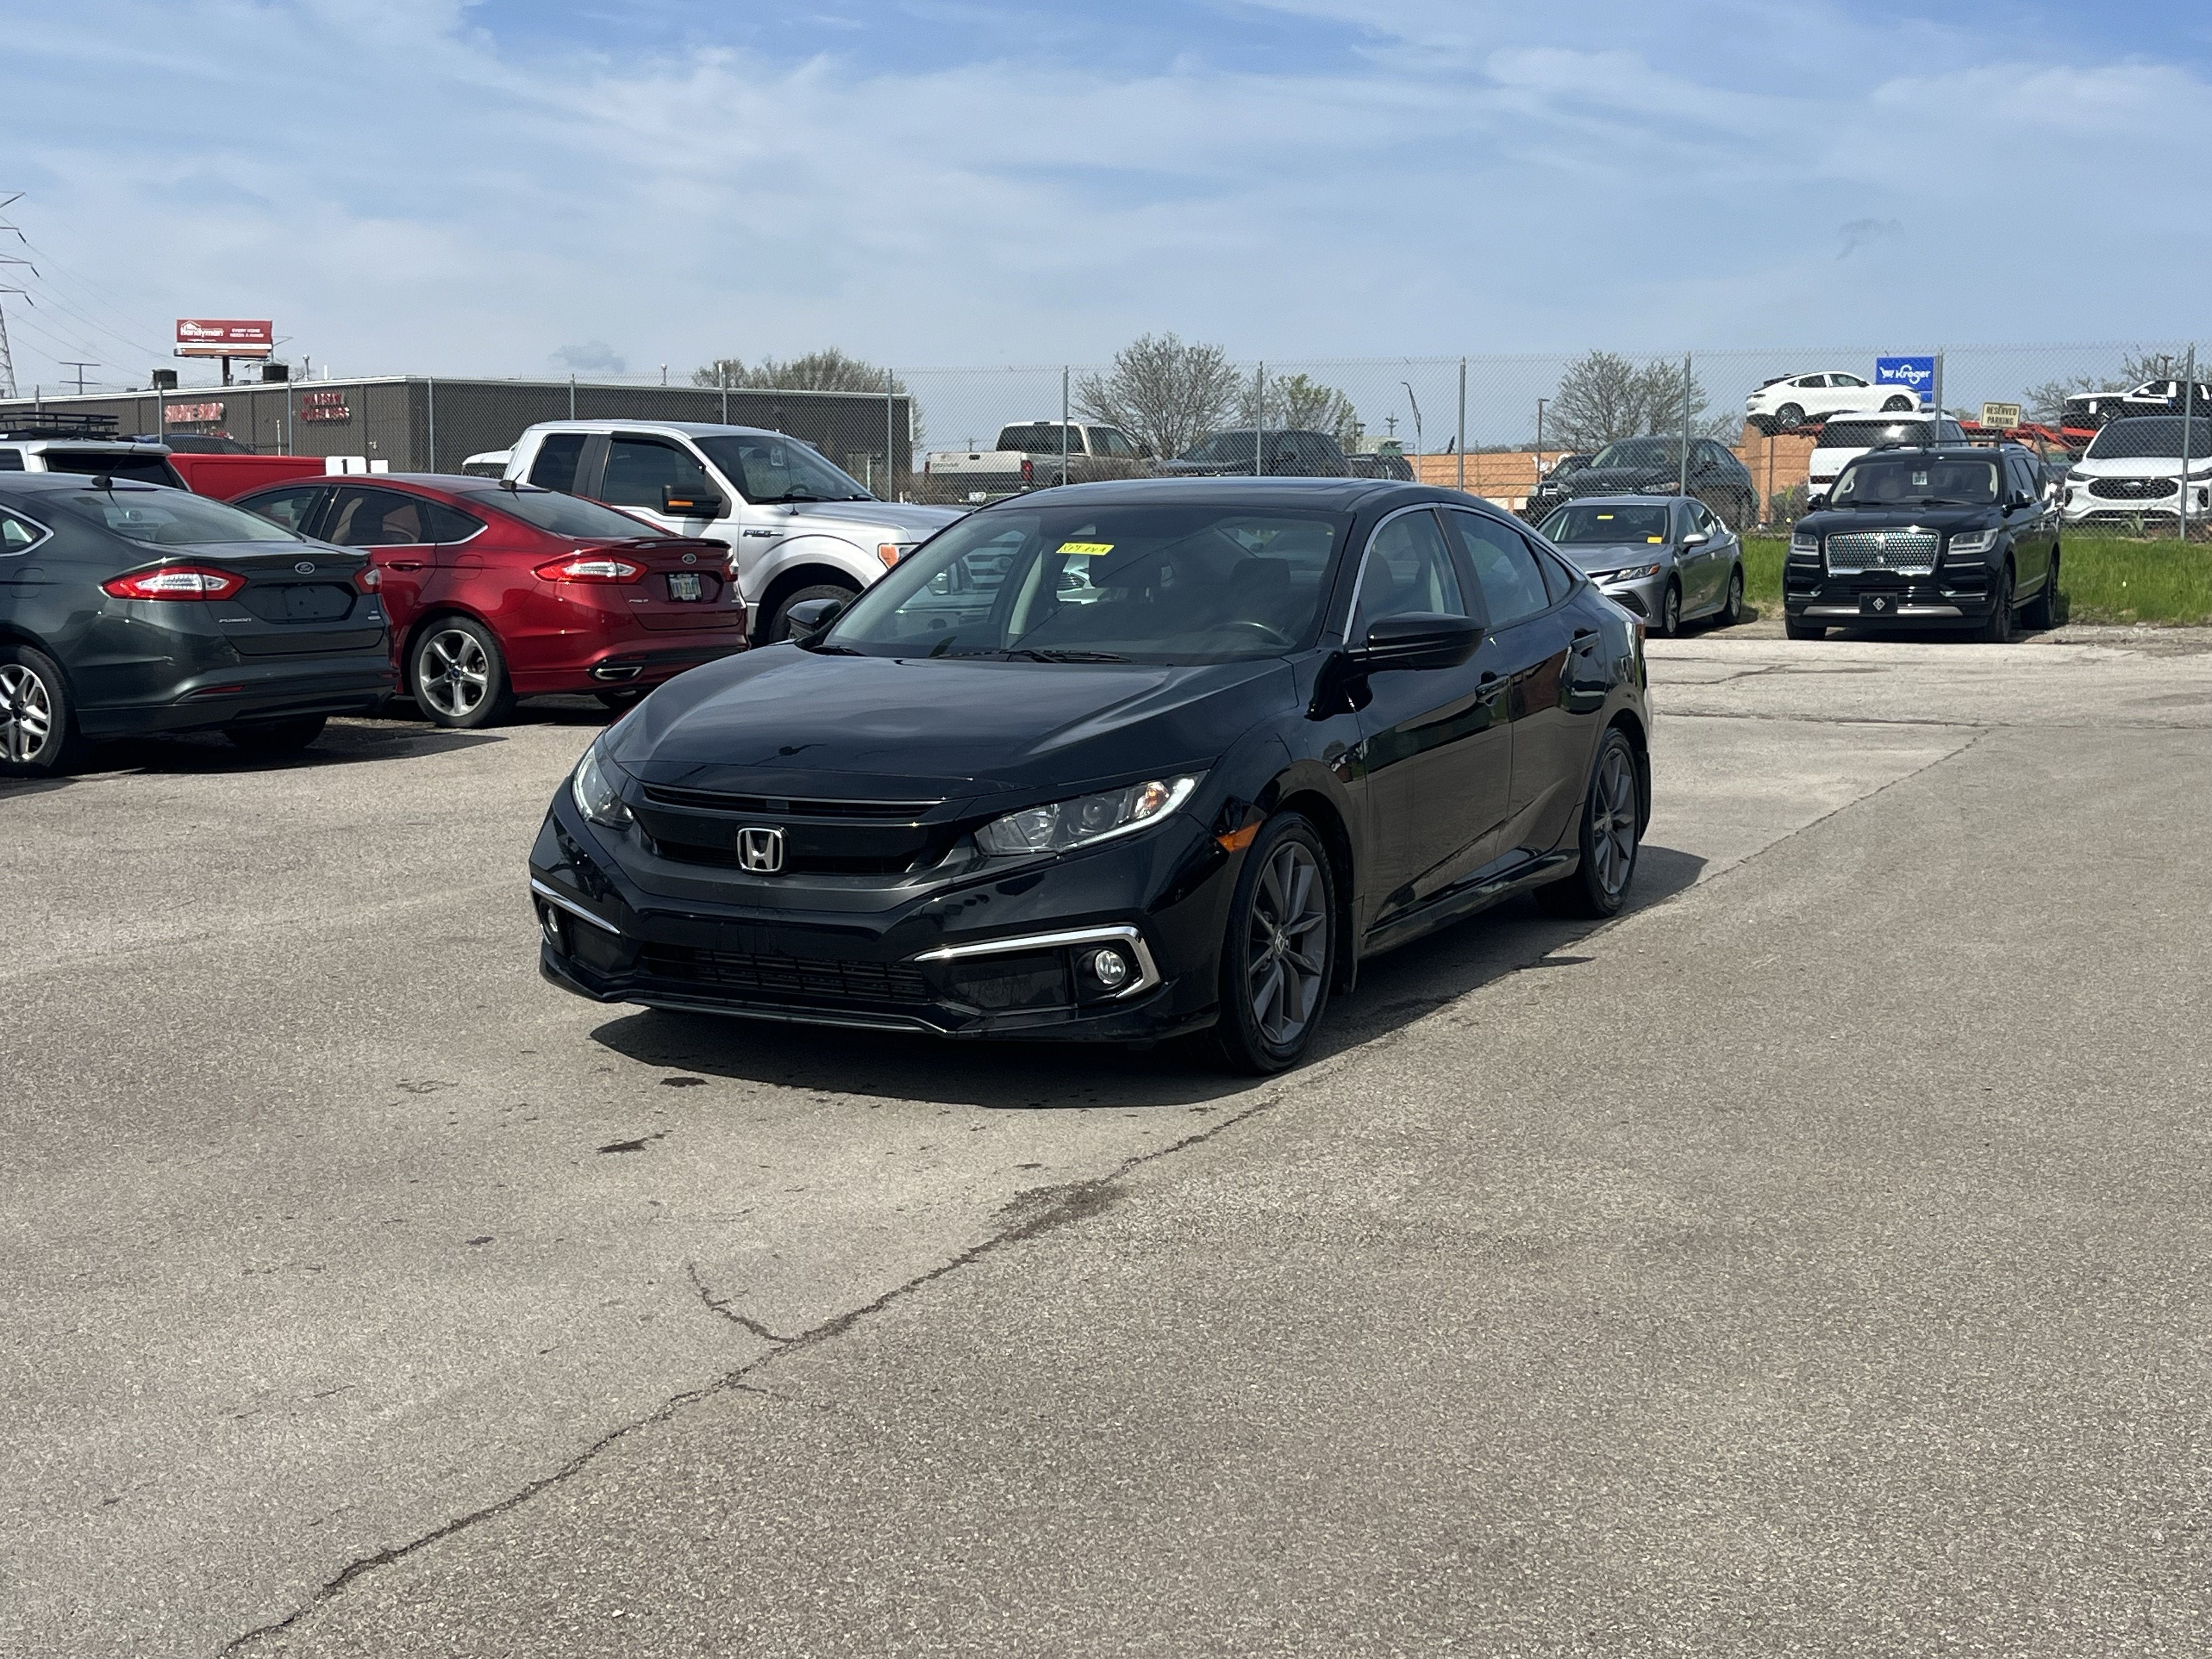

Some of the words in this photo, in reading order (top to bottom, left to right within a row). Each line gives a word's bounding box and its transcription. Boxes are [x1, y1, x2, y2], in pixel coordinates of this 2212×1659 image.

[180, 326, 224, 338] Handyman
[1895, 364, 1931, 384] Kroger
[1986, 406, 2017, 416] RESERVED
[1987, 416, 2014, 425] PARKING
